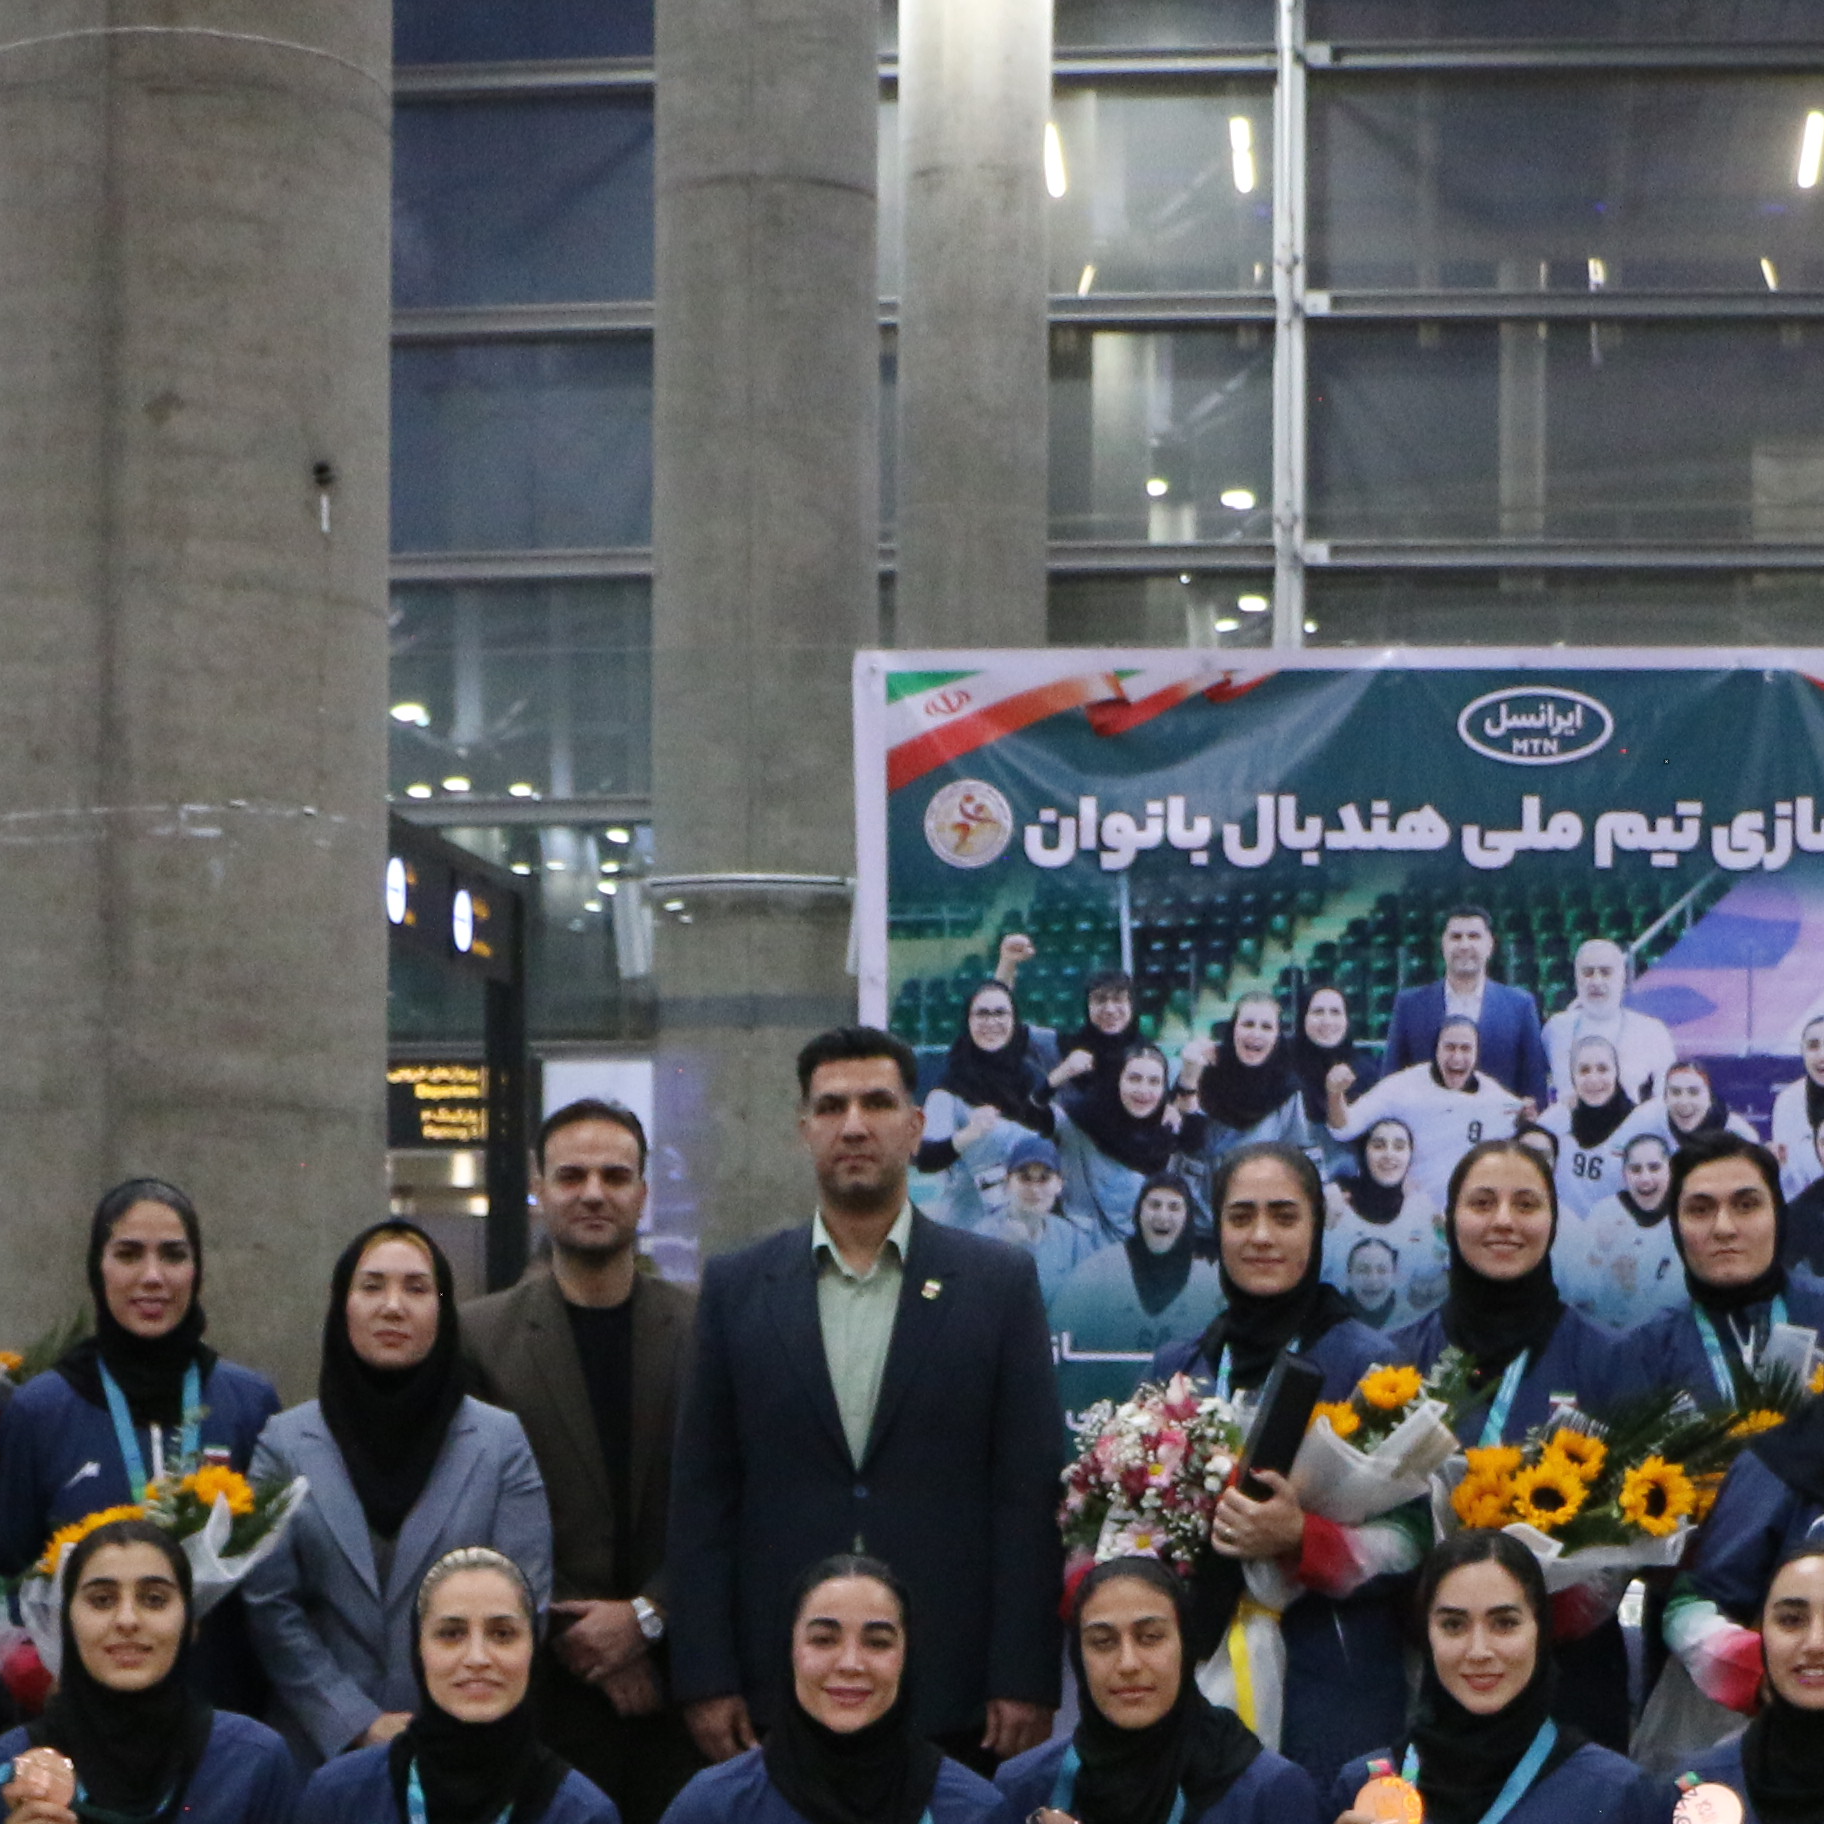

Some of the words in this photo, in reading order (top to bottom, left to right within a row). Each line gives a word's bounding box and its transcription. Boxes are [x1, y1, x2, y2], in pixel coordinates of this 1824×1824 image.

[1483, 702, 1584, 738] ایرانسل
[1512, 738, 1559, 755] MTN
[1023, 794, 1214, 870] بانوان
[1221, 793, 1451, 868] هندبال
[1461, 795, 1584, 869] ملی
[1594, 800, 1703, 868] تیم
[1573, 1152, 1603, 1180] 96
